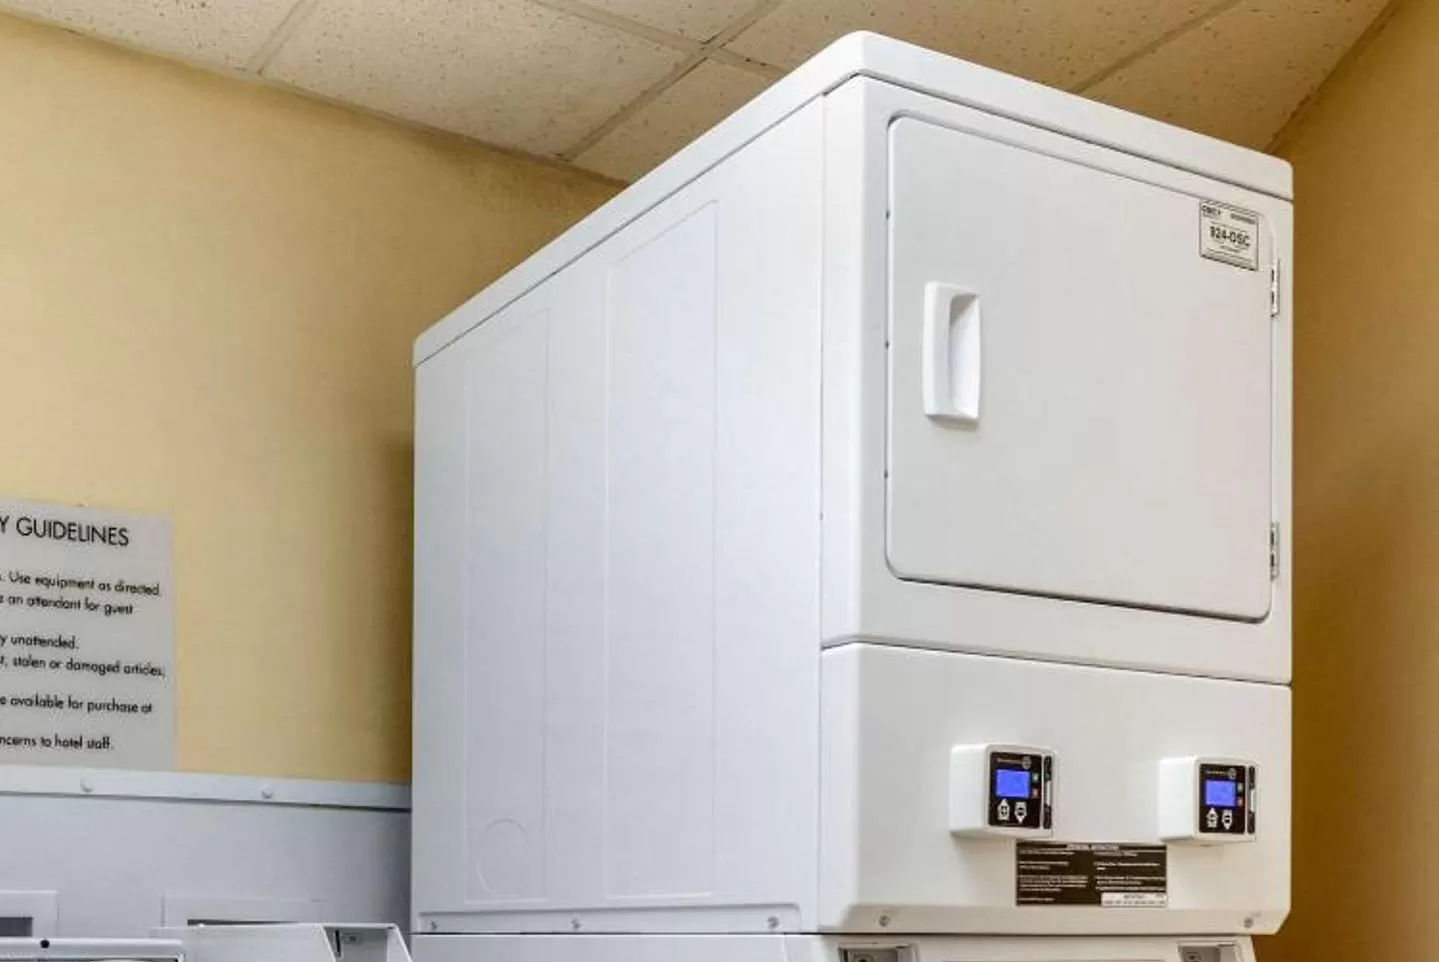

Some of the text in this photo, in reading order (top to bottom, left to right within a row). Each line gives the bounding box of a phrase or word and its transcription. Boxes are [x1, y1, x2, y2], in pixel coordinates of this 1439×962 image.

[17, 517, 129, 546] GUIDELINES
[9, 571, 30, 584] Use
[35, 575, 94, 588] equipment
[99, 582, 111, 591] as
[9, 595, 23, 604] an
[26, 596, 80, 609] attendant
[85, 597, 100, 611] for
[104, 604, 133, 616] guest
[11, 635, 79, 649] unattended.
[13, 654, 46, 668] stolen
[49, 661, 61, 669] or
[66, 658, 120, 676] damaged
[11, 693, 64, 709] available
[68, 696, 83, 709] for
[87, 698, 138, 713] purchase
[141, 704, 152, 713] at
[41, 736, 51, 747] to
[55, 733, 82, 748] hotel
[87, 736, 114, 749] staff.
